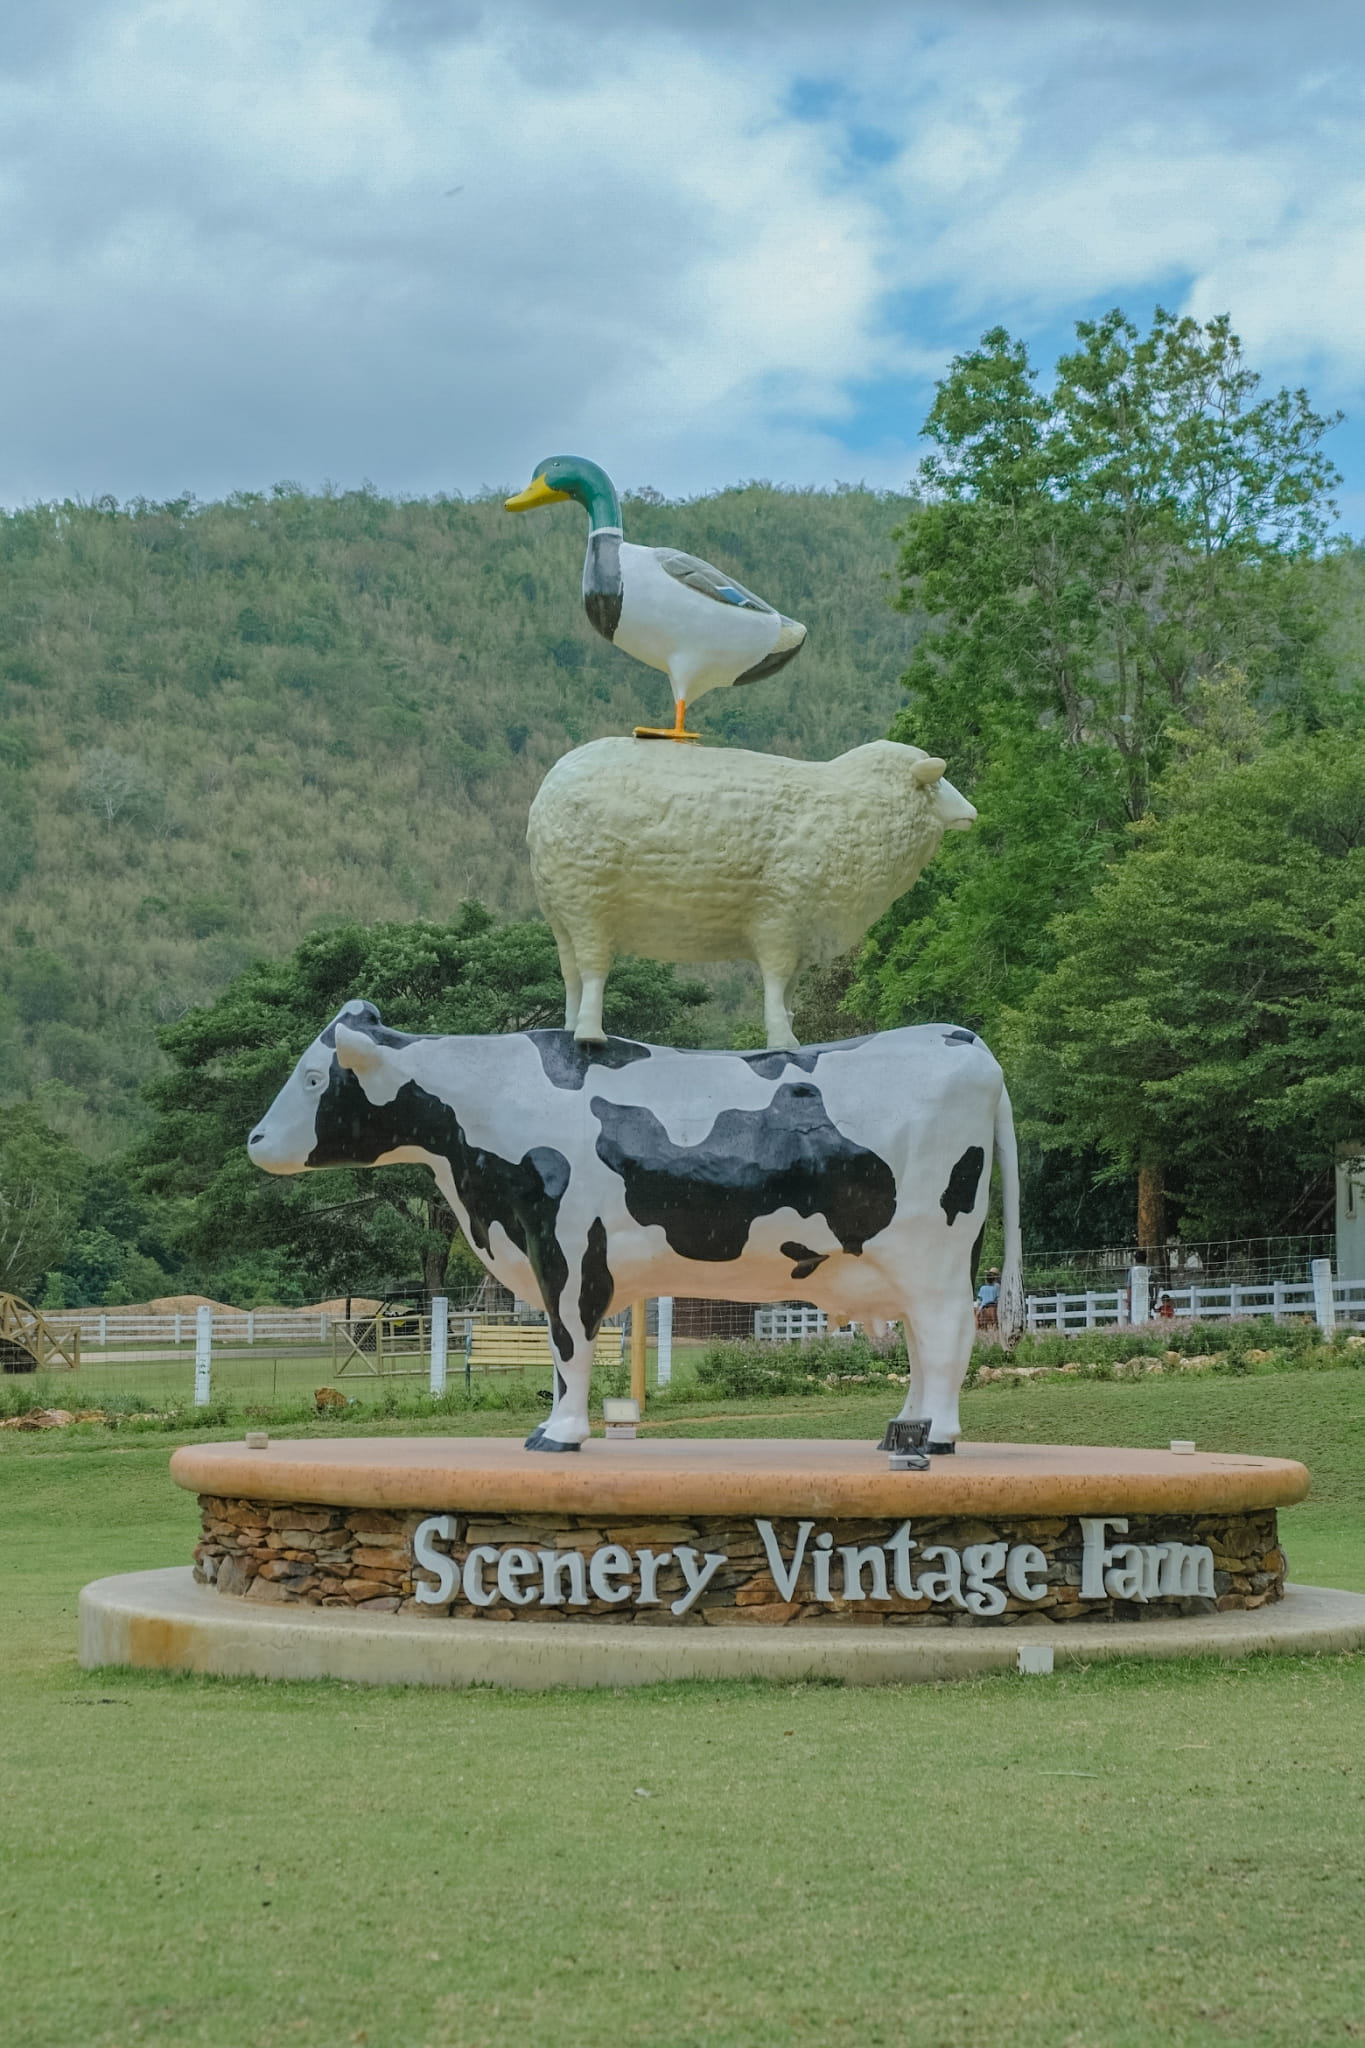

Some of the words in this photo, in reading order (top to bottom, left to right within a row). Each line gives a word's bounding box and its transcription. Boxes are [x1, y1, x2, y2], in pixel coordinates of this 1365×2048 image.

[414, 1515, 728, 1616] Scenery
[755, 1519, 1048, 1616] Vintage
[1078, 1518, 1217, 1603] Farm
